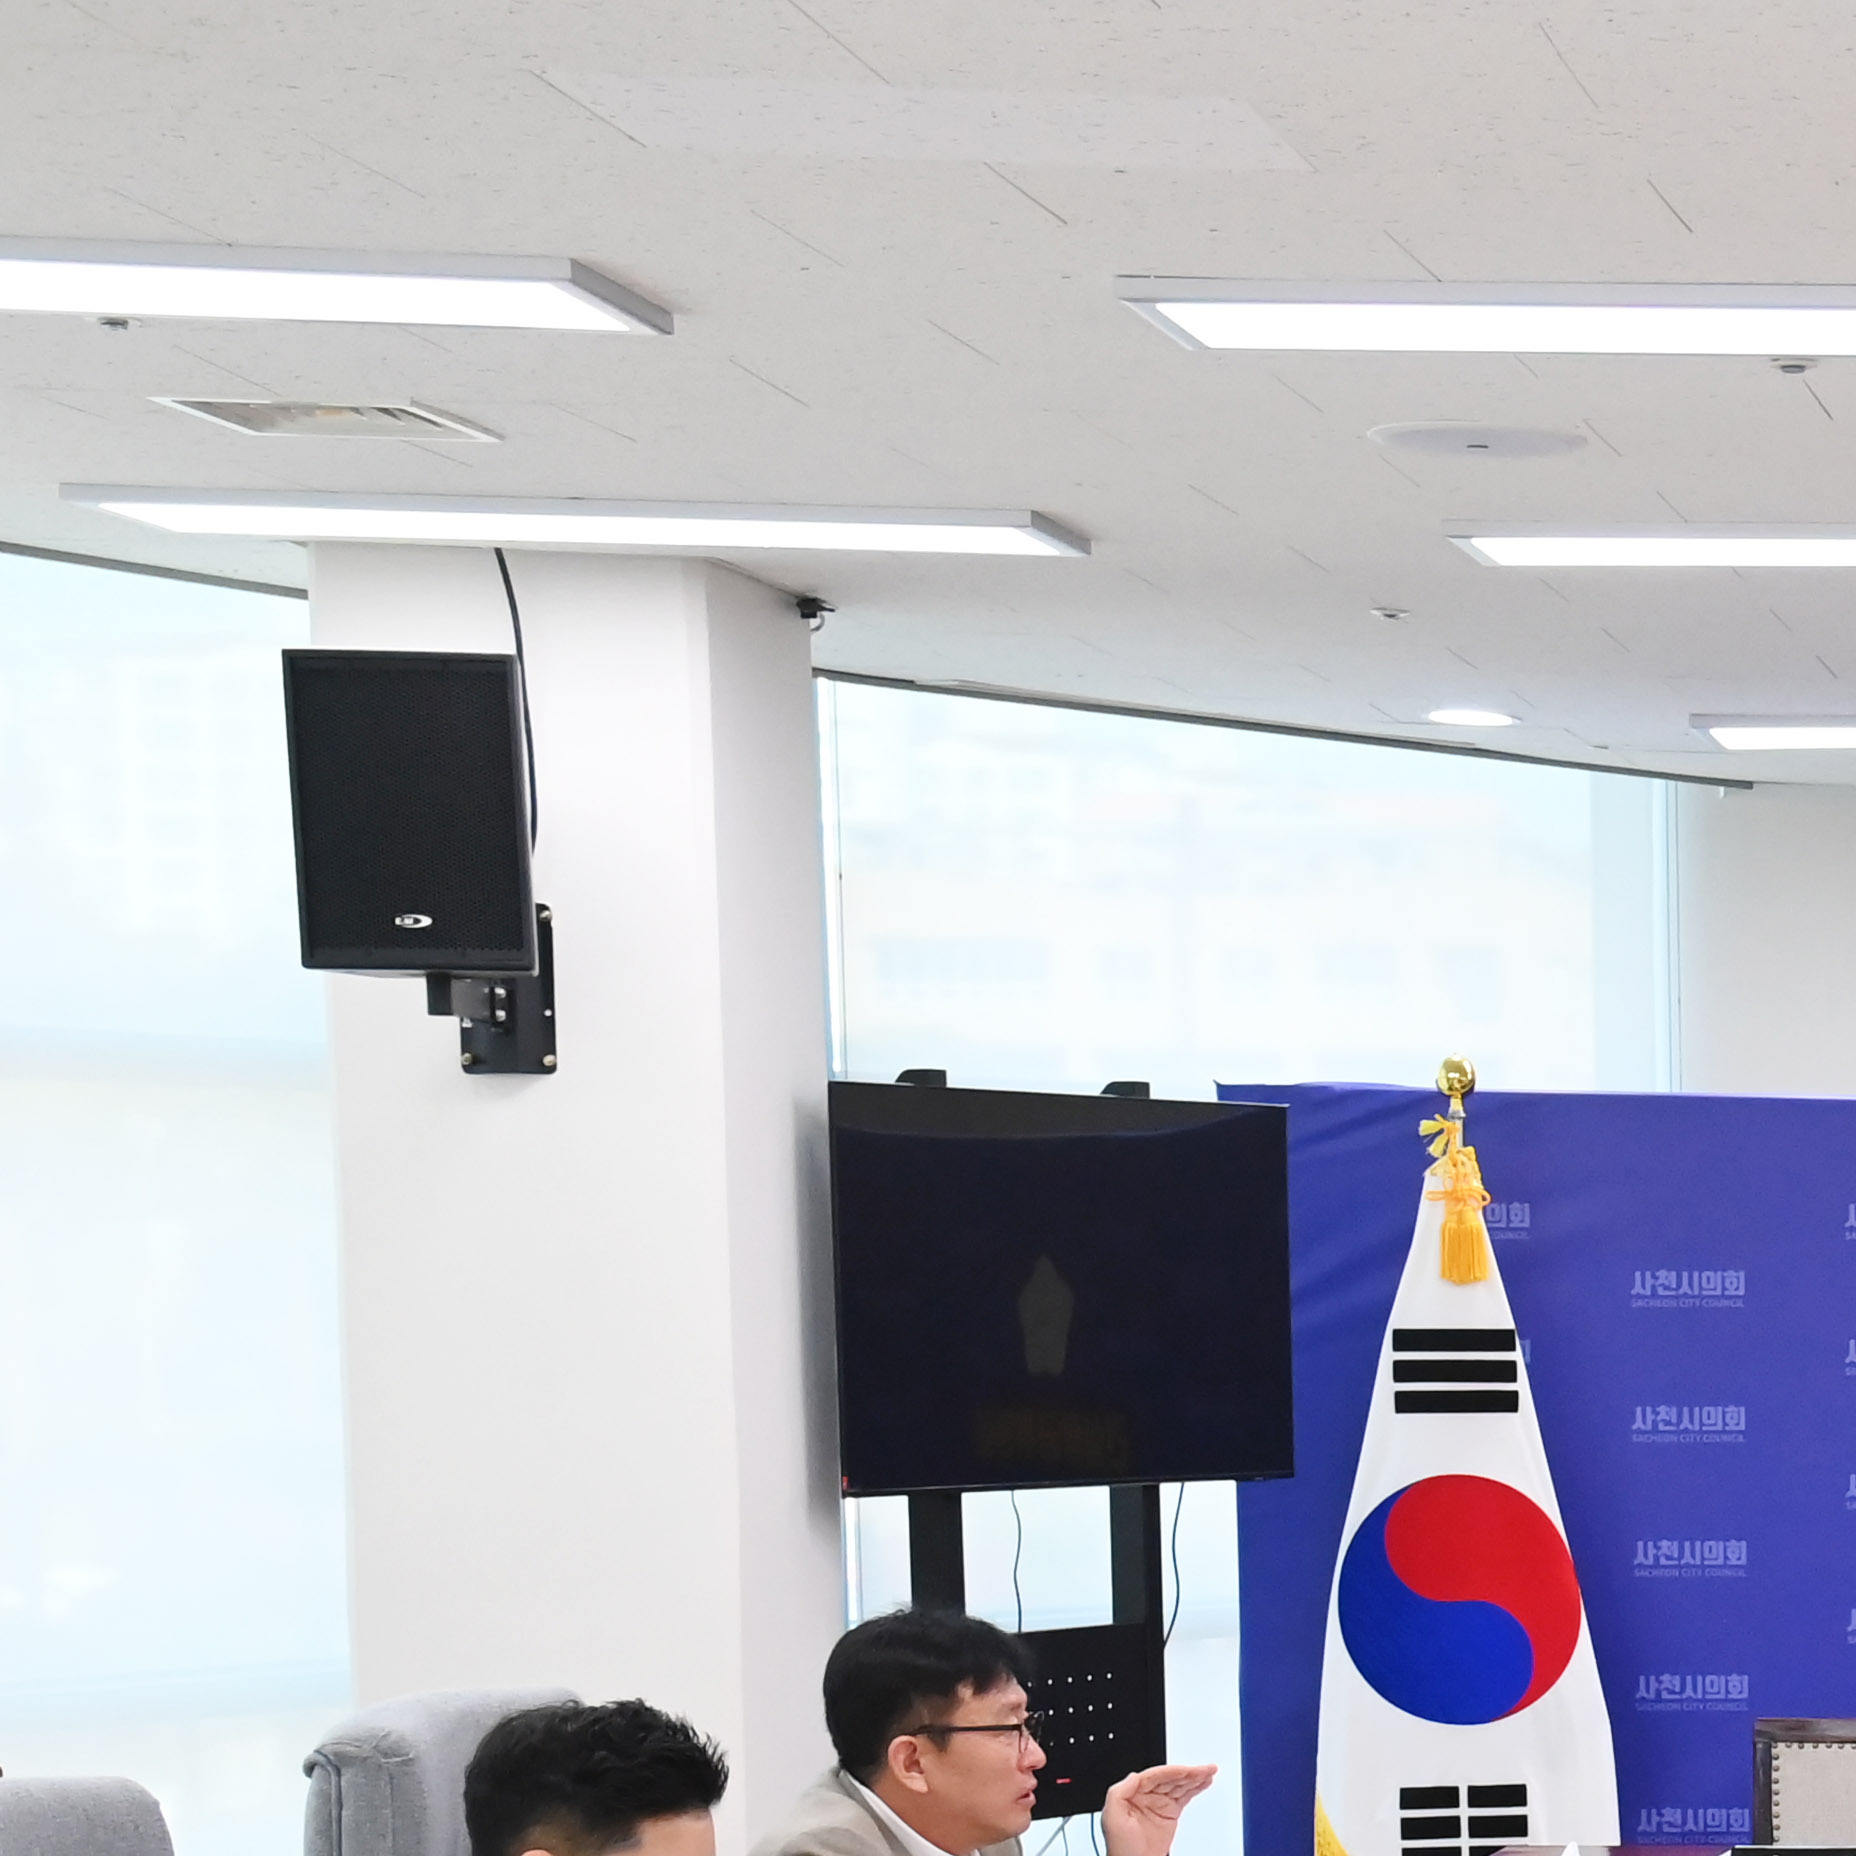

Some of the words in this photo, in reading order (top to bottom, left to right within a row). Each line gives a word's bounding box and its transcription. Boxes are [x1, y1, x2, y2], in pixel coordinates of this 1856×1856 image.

[1631, 1269, 1745, 1295] 사천시의회
[1631, 1405, 1745, 1431] 사천시의회
[1634, 1539, 1747, 1565] 사천시의회
[1636, 1673, 1749, 1699] 사천시의회
[1637, 1807, 1750, 1833] 사천시의회
